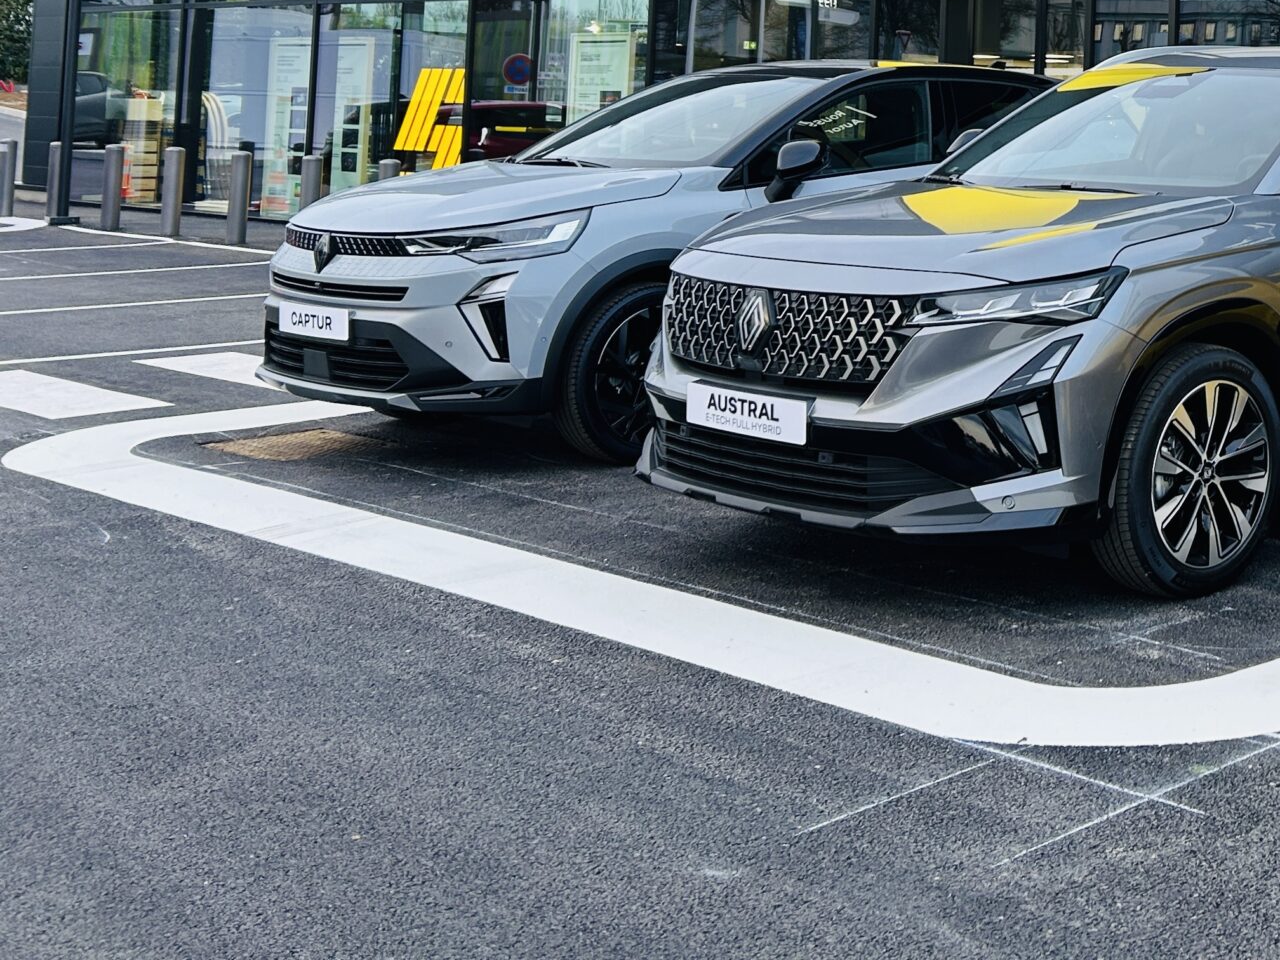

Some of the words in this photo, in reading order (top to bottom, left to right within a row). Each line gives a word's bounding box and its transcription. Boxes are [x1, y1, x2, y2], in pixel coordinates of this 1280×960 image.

[290, 311, 333, 331] CAPTUR
[707, 393, 780, 422] AUSTRAL
[705, 412, 731, 426] E-TECH
[731, 417, 750, 430] FULL
[751, 422, 782, 435] HYBRID
